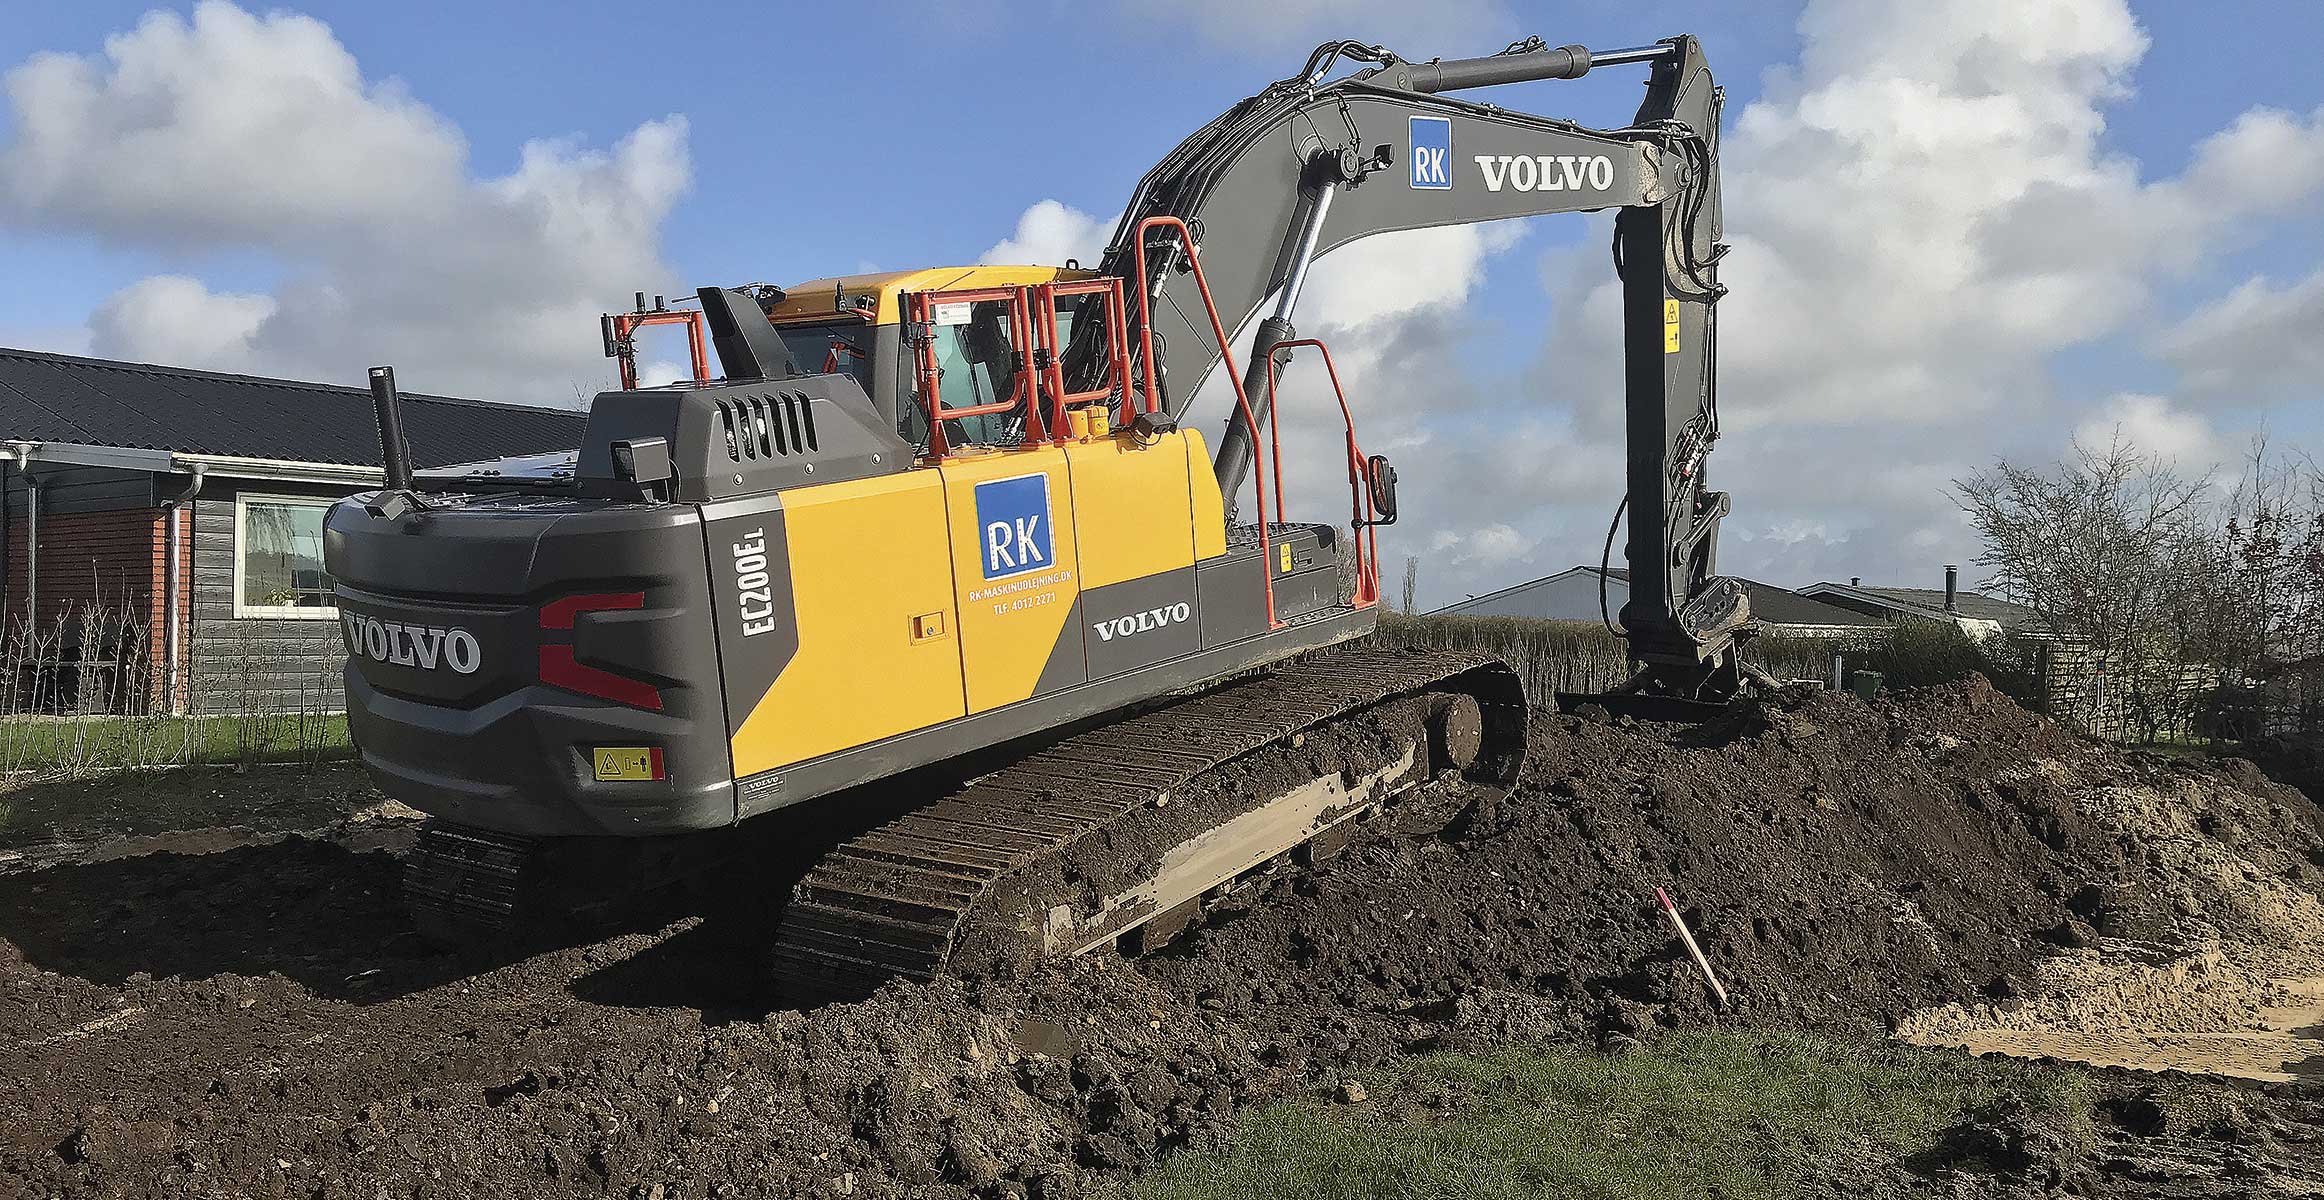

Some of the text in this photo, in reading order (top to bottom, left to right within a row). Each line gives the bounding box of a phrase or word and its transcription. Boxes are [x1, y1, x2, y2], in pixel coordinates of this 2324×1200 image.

[1415, 146, 1446, 183] RK
[1474, 155, 1614, 192] VOLVO
[987, 514, 1044, 570] RK
[969, 570, 1072, 602] RK-MASKINUDLEJNING.DK
[993, 591, 1056, 616] TLF. 4012 2271
[1092, 602, 1190, 642] VOLVO
[343, 609, 481, 674] VOLVO
